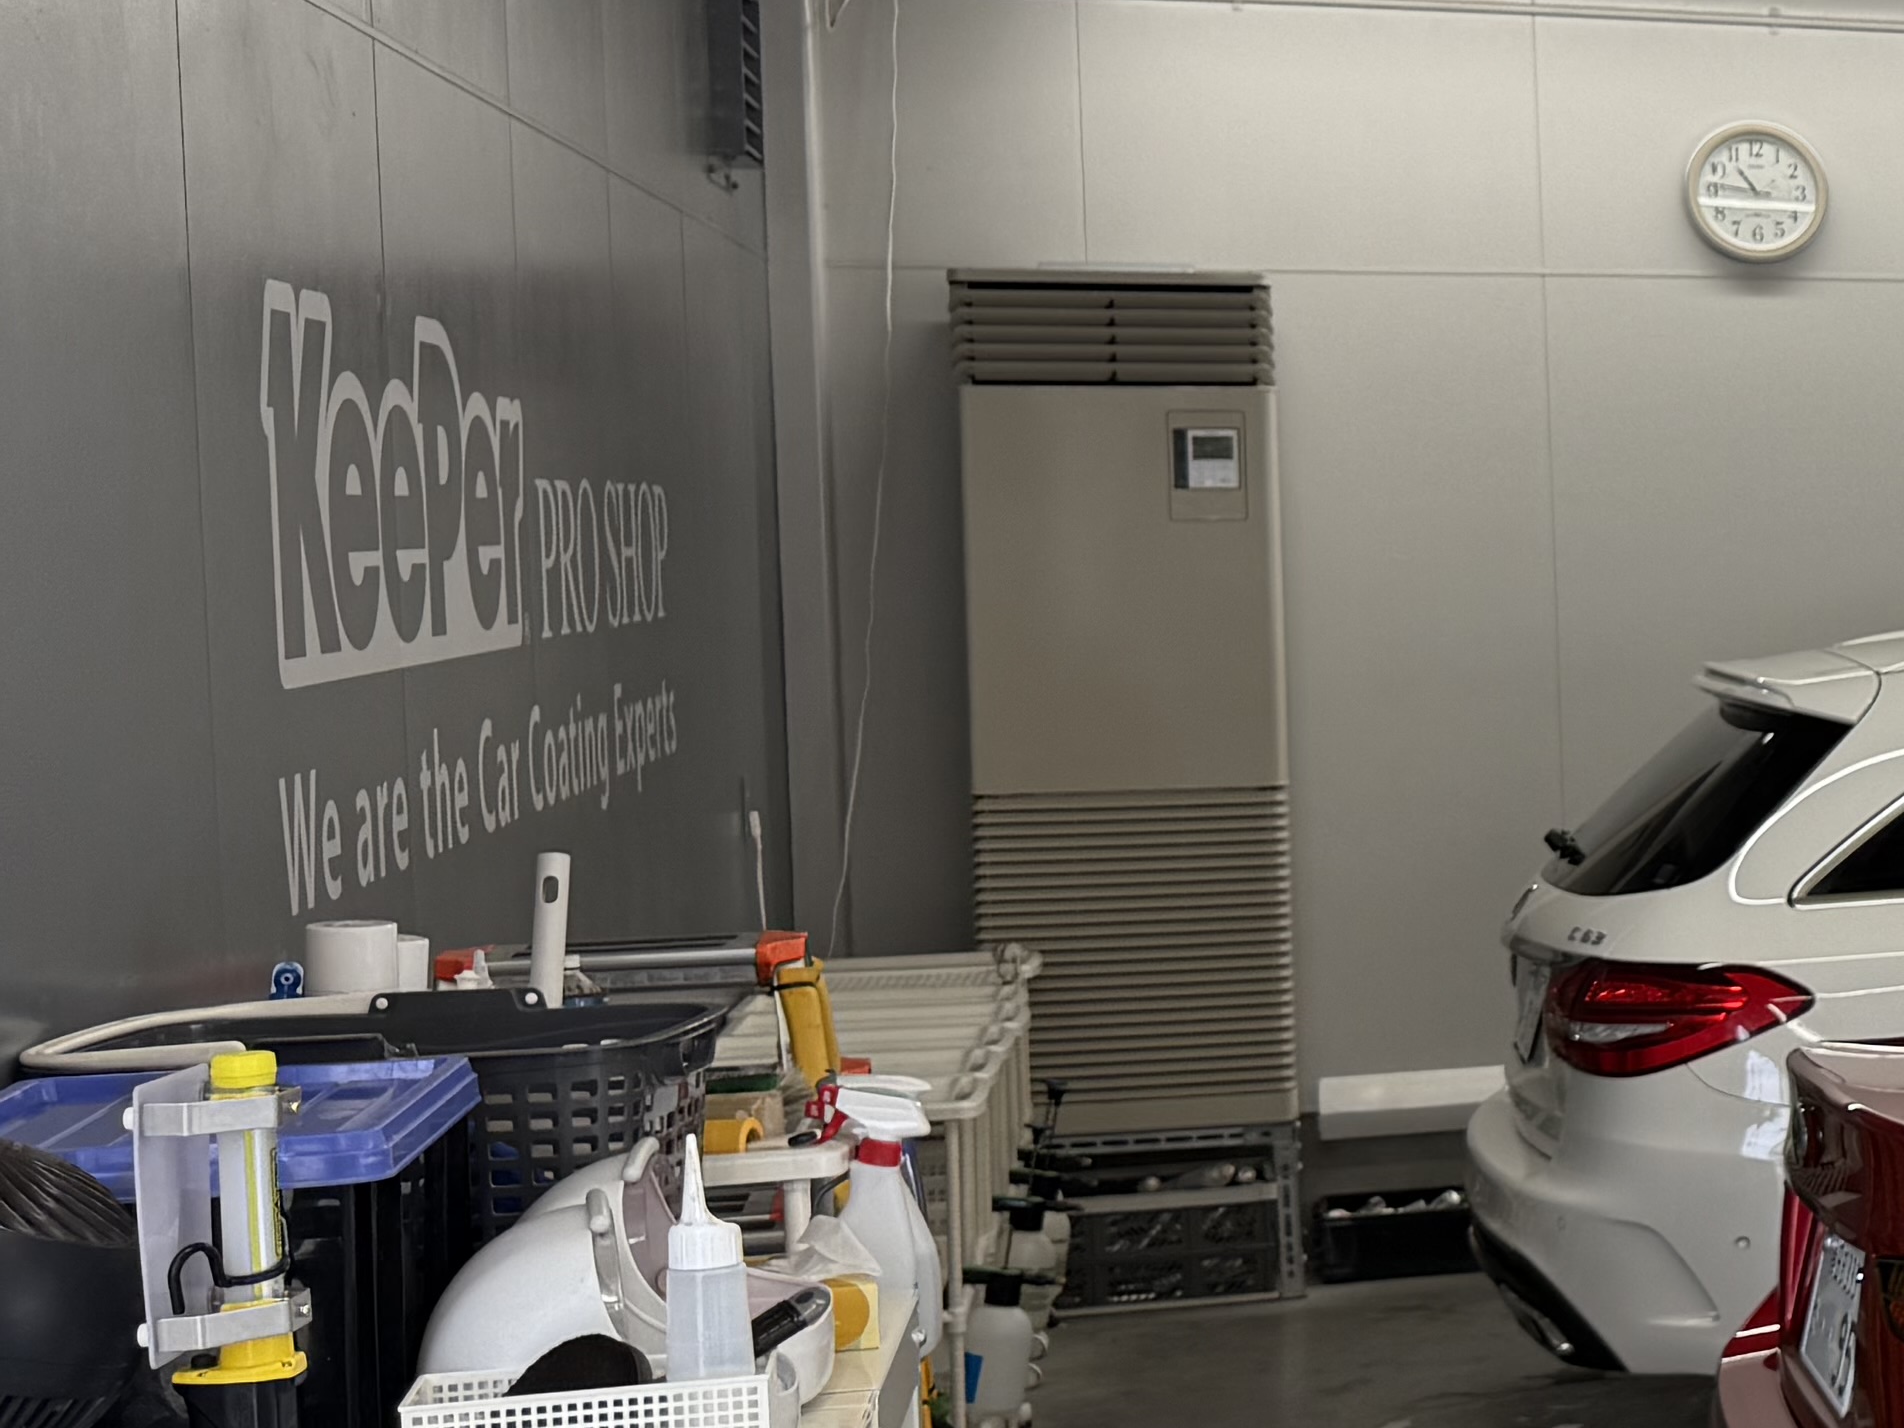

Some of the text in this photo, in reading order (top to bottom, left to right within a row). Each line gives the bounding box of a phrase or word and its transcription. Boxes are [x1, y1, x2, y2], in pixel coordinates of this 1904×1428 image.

[1728, 146, 1739, 163] 11
[1748, 141, 1764, 158] 12
[1711, 161, 1726, 179] 10
[1788, 164, 1798, 179] 2
[1795, 185, 1807, 202] 3
[1714, 207, 1726, 221] 8
[1731, 220, 1742, 237] 7
[1752, 225, 1764, 243] 6
[1774, 221, 1786, 238] 5
[261, 279, 669, 689] KeePer PRO SHOP
[279, 678, 678, 917] We are the Car Coating Experts
